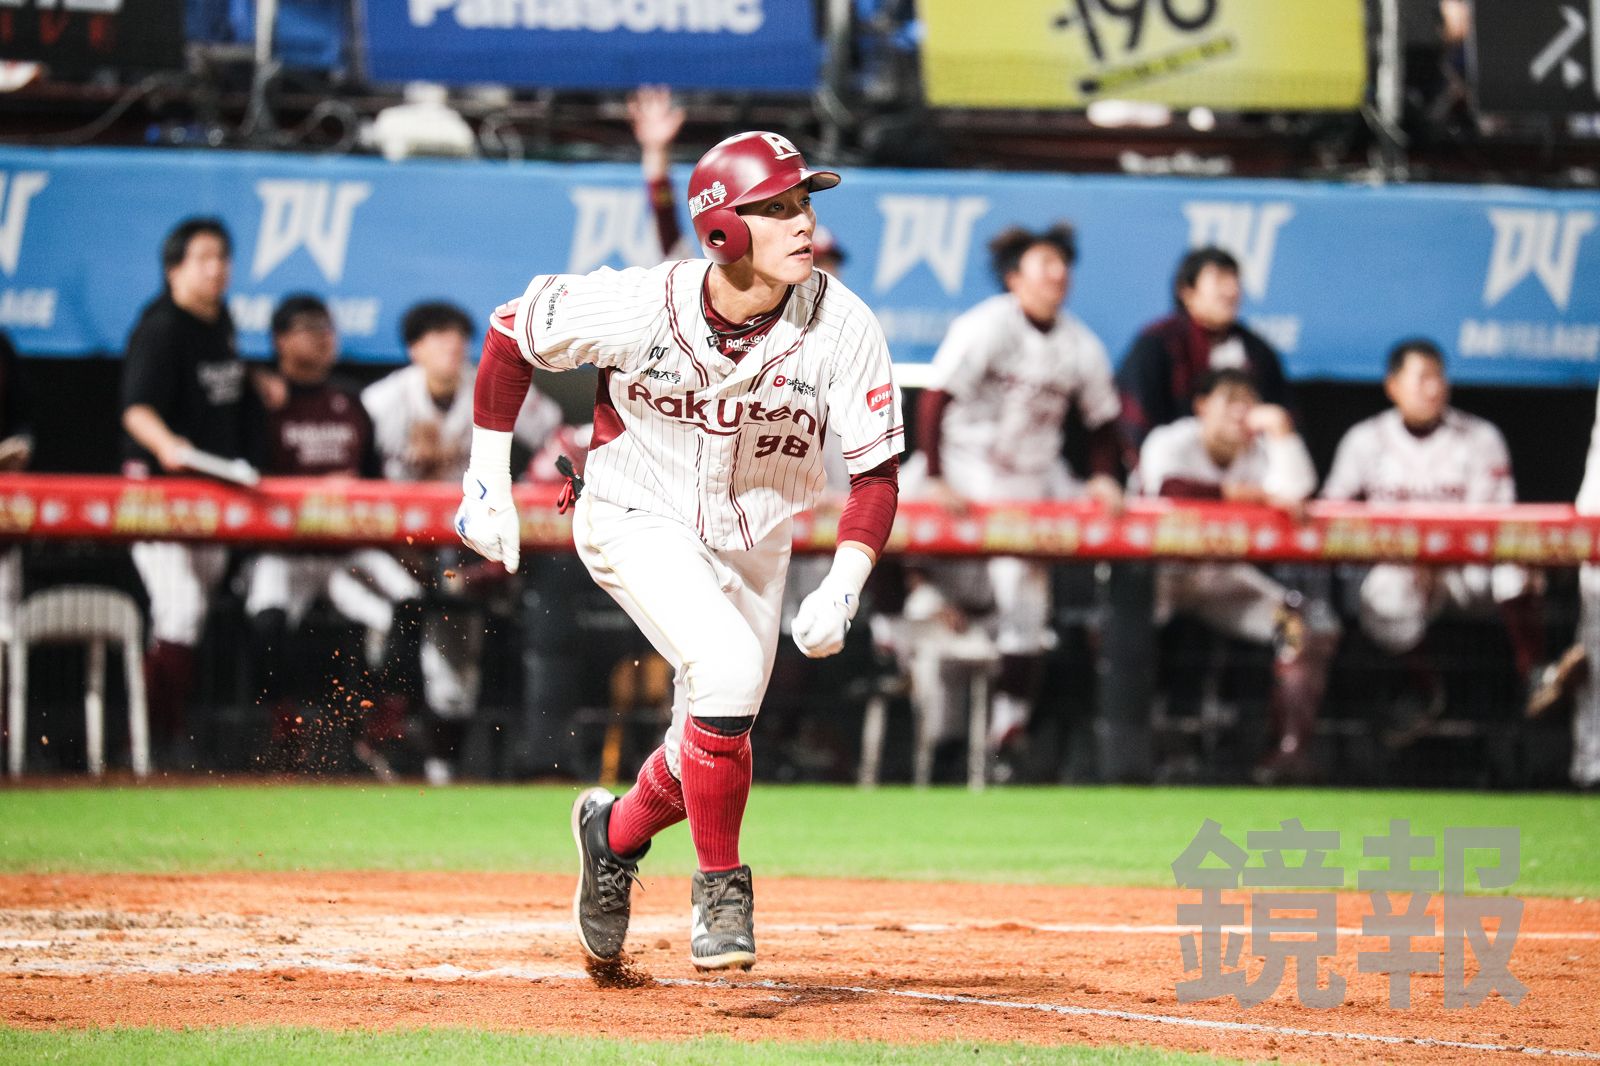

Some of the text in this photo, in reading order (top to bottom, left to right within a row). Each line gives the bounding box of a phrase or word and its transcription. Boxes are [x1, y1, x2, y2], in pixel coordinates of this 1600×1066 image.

[761, 133, 801, 160] R
[628, 381, 817, 437] Rakuten
[754, 434, 809, 459] 98
